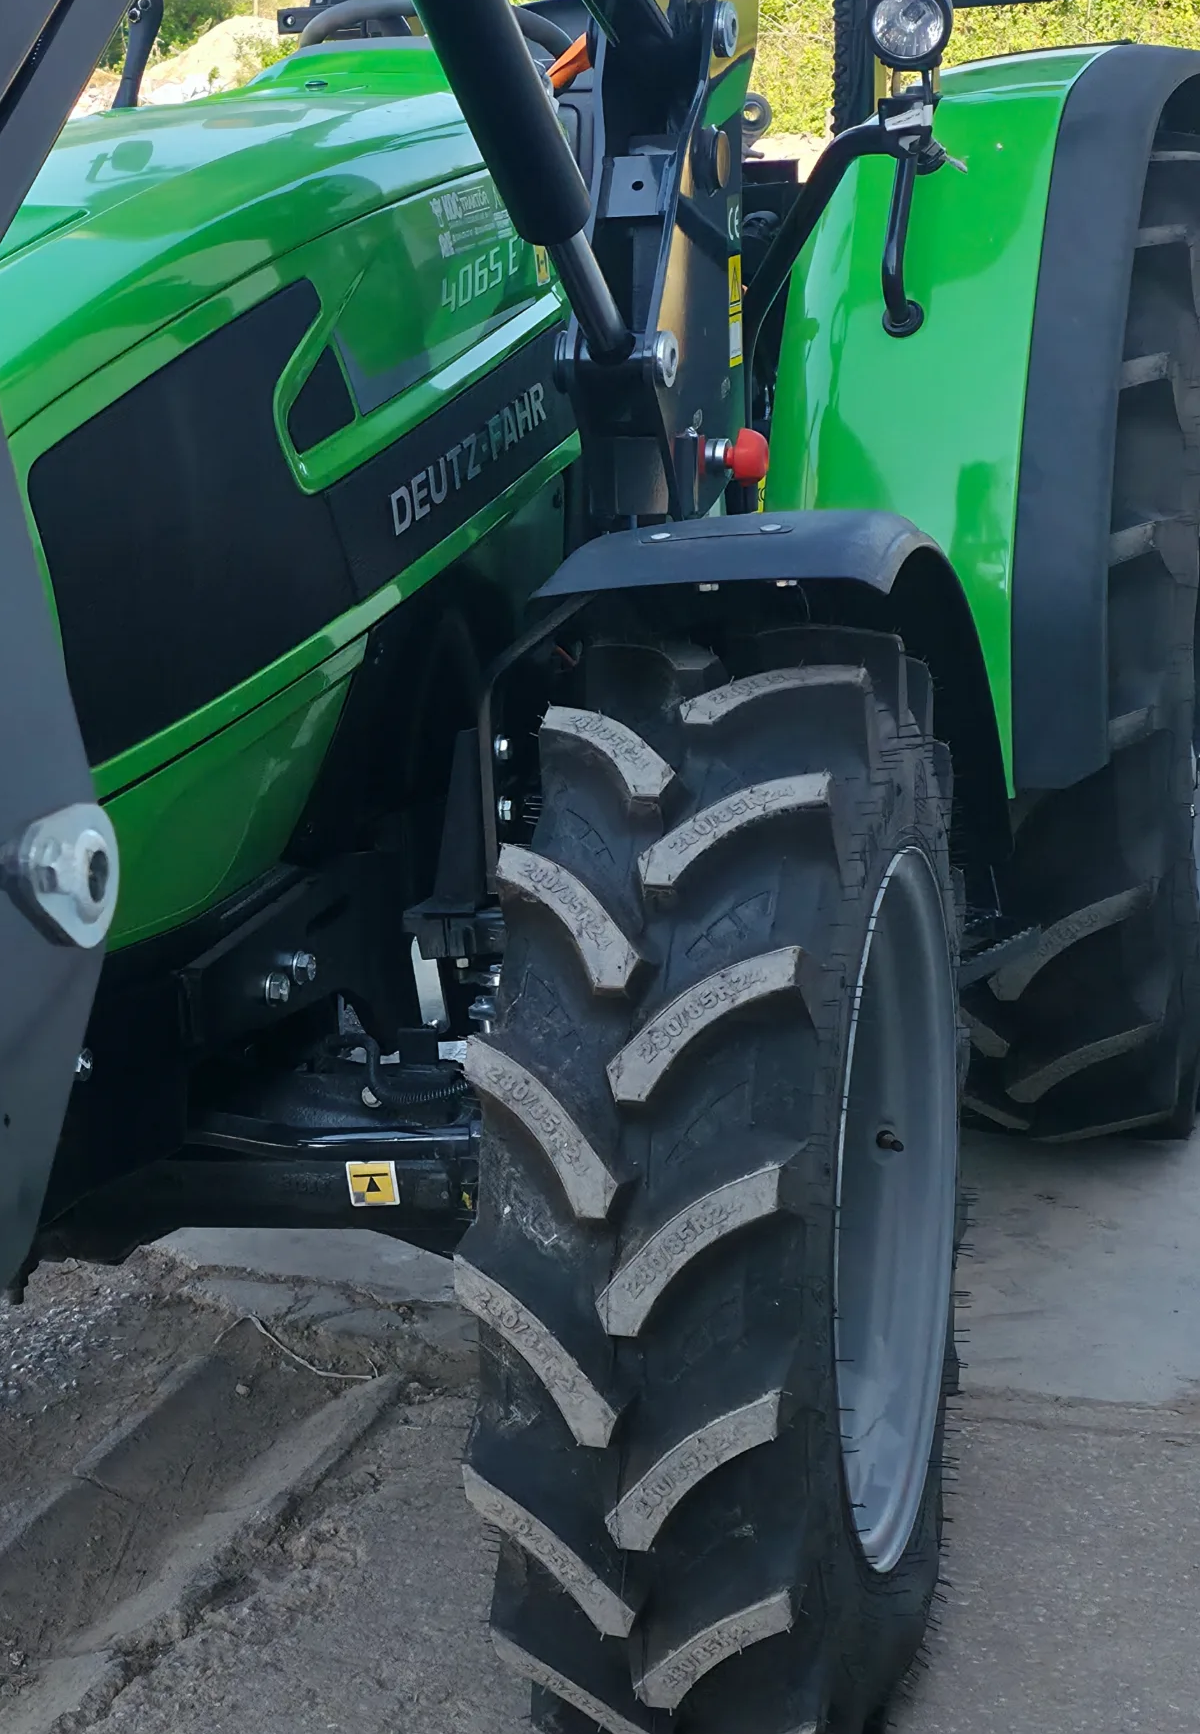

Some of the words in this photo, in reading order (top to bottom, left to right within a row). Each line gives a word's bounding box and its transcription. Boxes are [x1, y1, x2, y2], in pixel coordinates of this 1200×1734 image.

[442, 246, 502, 312] 4065
[390, 382, 546, 536] DEUTZ-FAHR
[637, 970, 767, 1064] 280/85R24
